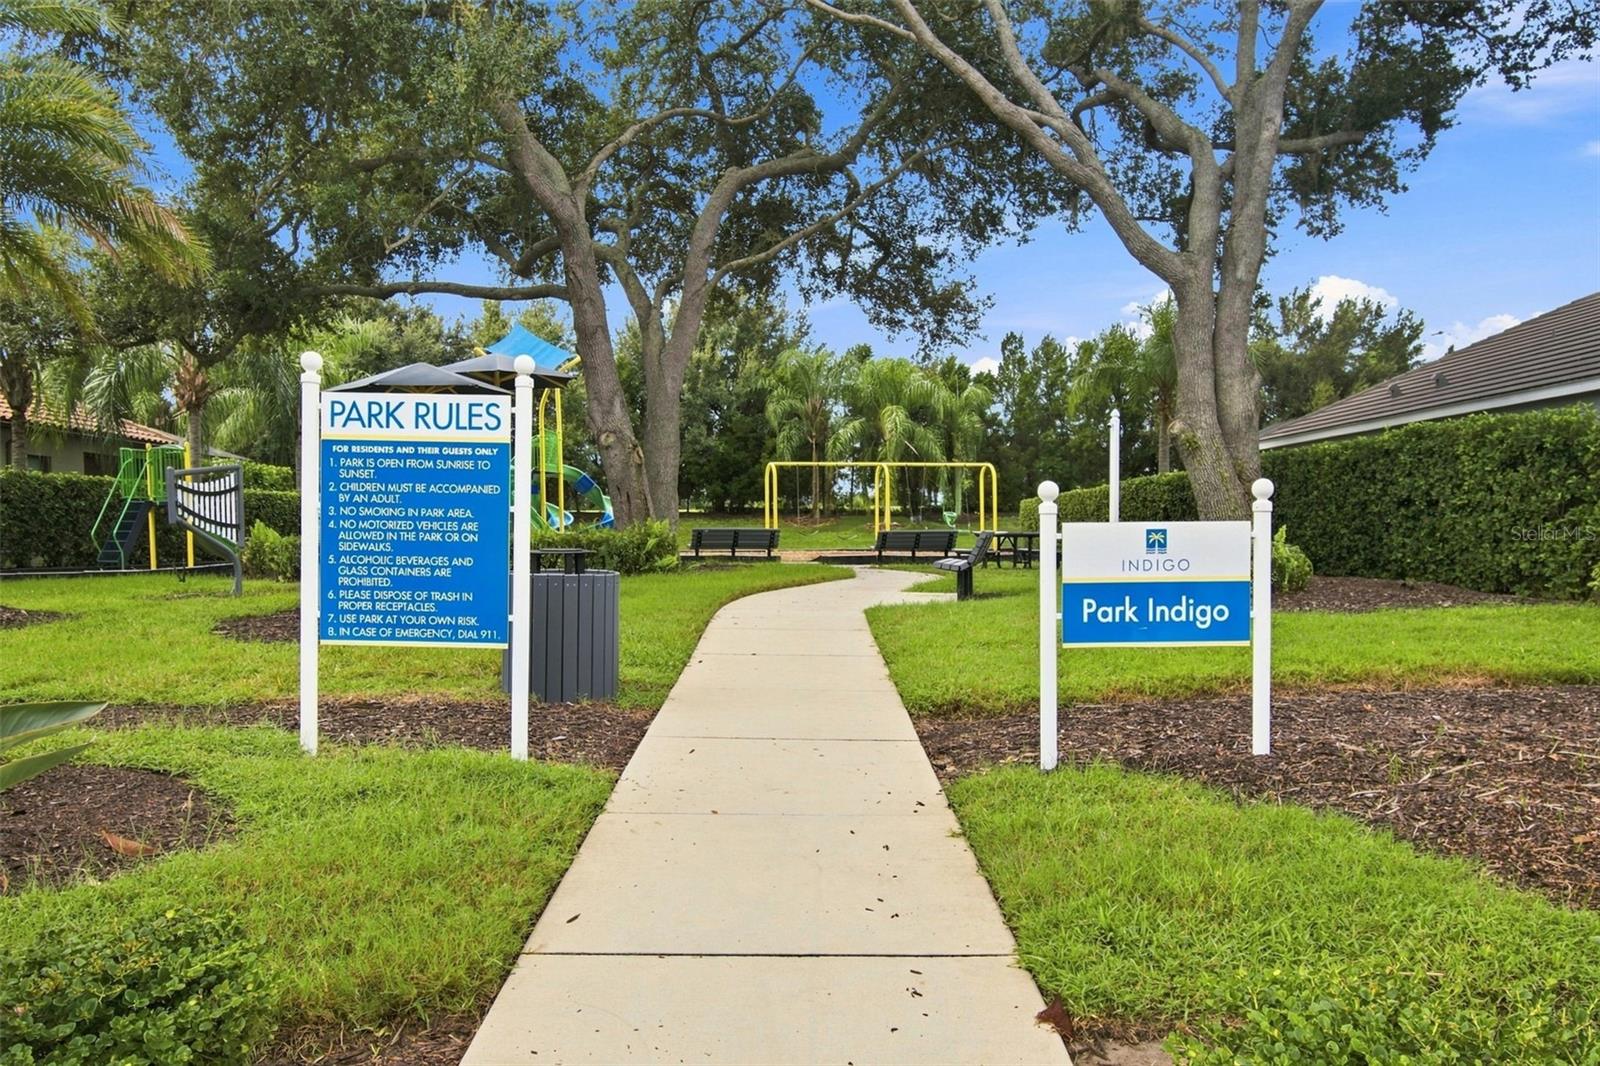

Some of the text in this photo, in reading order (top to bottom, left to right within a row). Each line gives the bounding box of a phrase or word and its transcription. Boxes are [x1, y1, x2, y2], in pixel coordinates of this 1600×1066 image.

[330, 400, 501, 430] PARK RULES
[352, 445, 393, 453] RESIDENTS
[330, 458, 490, 470] 1. PARK IS OPEN FROM SUNRISE TO
[339, 469, 377, 478] SUNSET.
[329, 482, 500, 494] 2. CHILDREN MUST BE ACCOMPANIED
[339, 494, 402, 503] BY AN ADULT.
[328, 507, 337, 515] 3.
[340, 507, 356, 515] NO
[359, 507, 405, 517] SMOKING
[408, 508, 418, 516] IN
[421, 508, 445, 517] PARK
[328, 520, 479, 531] 4. NO MOTORIZED VEHICLES ARE
[338, 531, 478, 542] ALLOWED IN THE PARK OR ON
[338, 542, 393, 552] SIDEWALKS.
[328, 555, 473, 566] 5. ALCOHOLIC BEVERAGES AND
[1122, 559, 1190, 571] INDIGO
[338, 566, 452, 577] GLASS CONTAINERS ARE
[338, 577, 392, 587] PROHIBITED.
[328, 590, 473, 601] 6. PLEASE DISPOSE OF TRASH IN
[338, 602, 438, 612] PROPER RECEPTACLES.
[1083, 596, 1229, 629] Park Indigo
[328, 614, 479, 625] 7. USE PARK AT YOUR OWN RISK.
[328, 627, 500, 640] 8. IN CASE OF EMERGENCY, DIAL 911.
